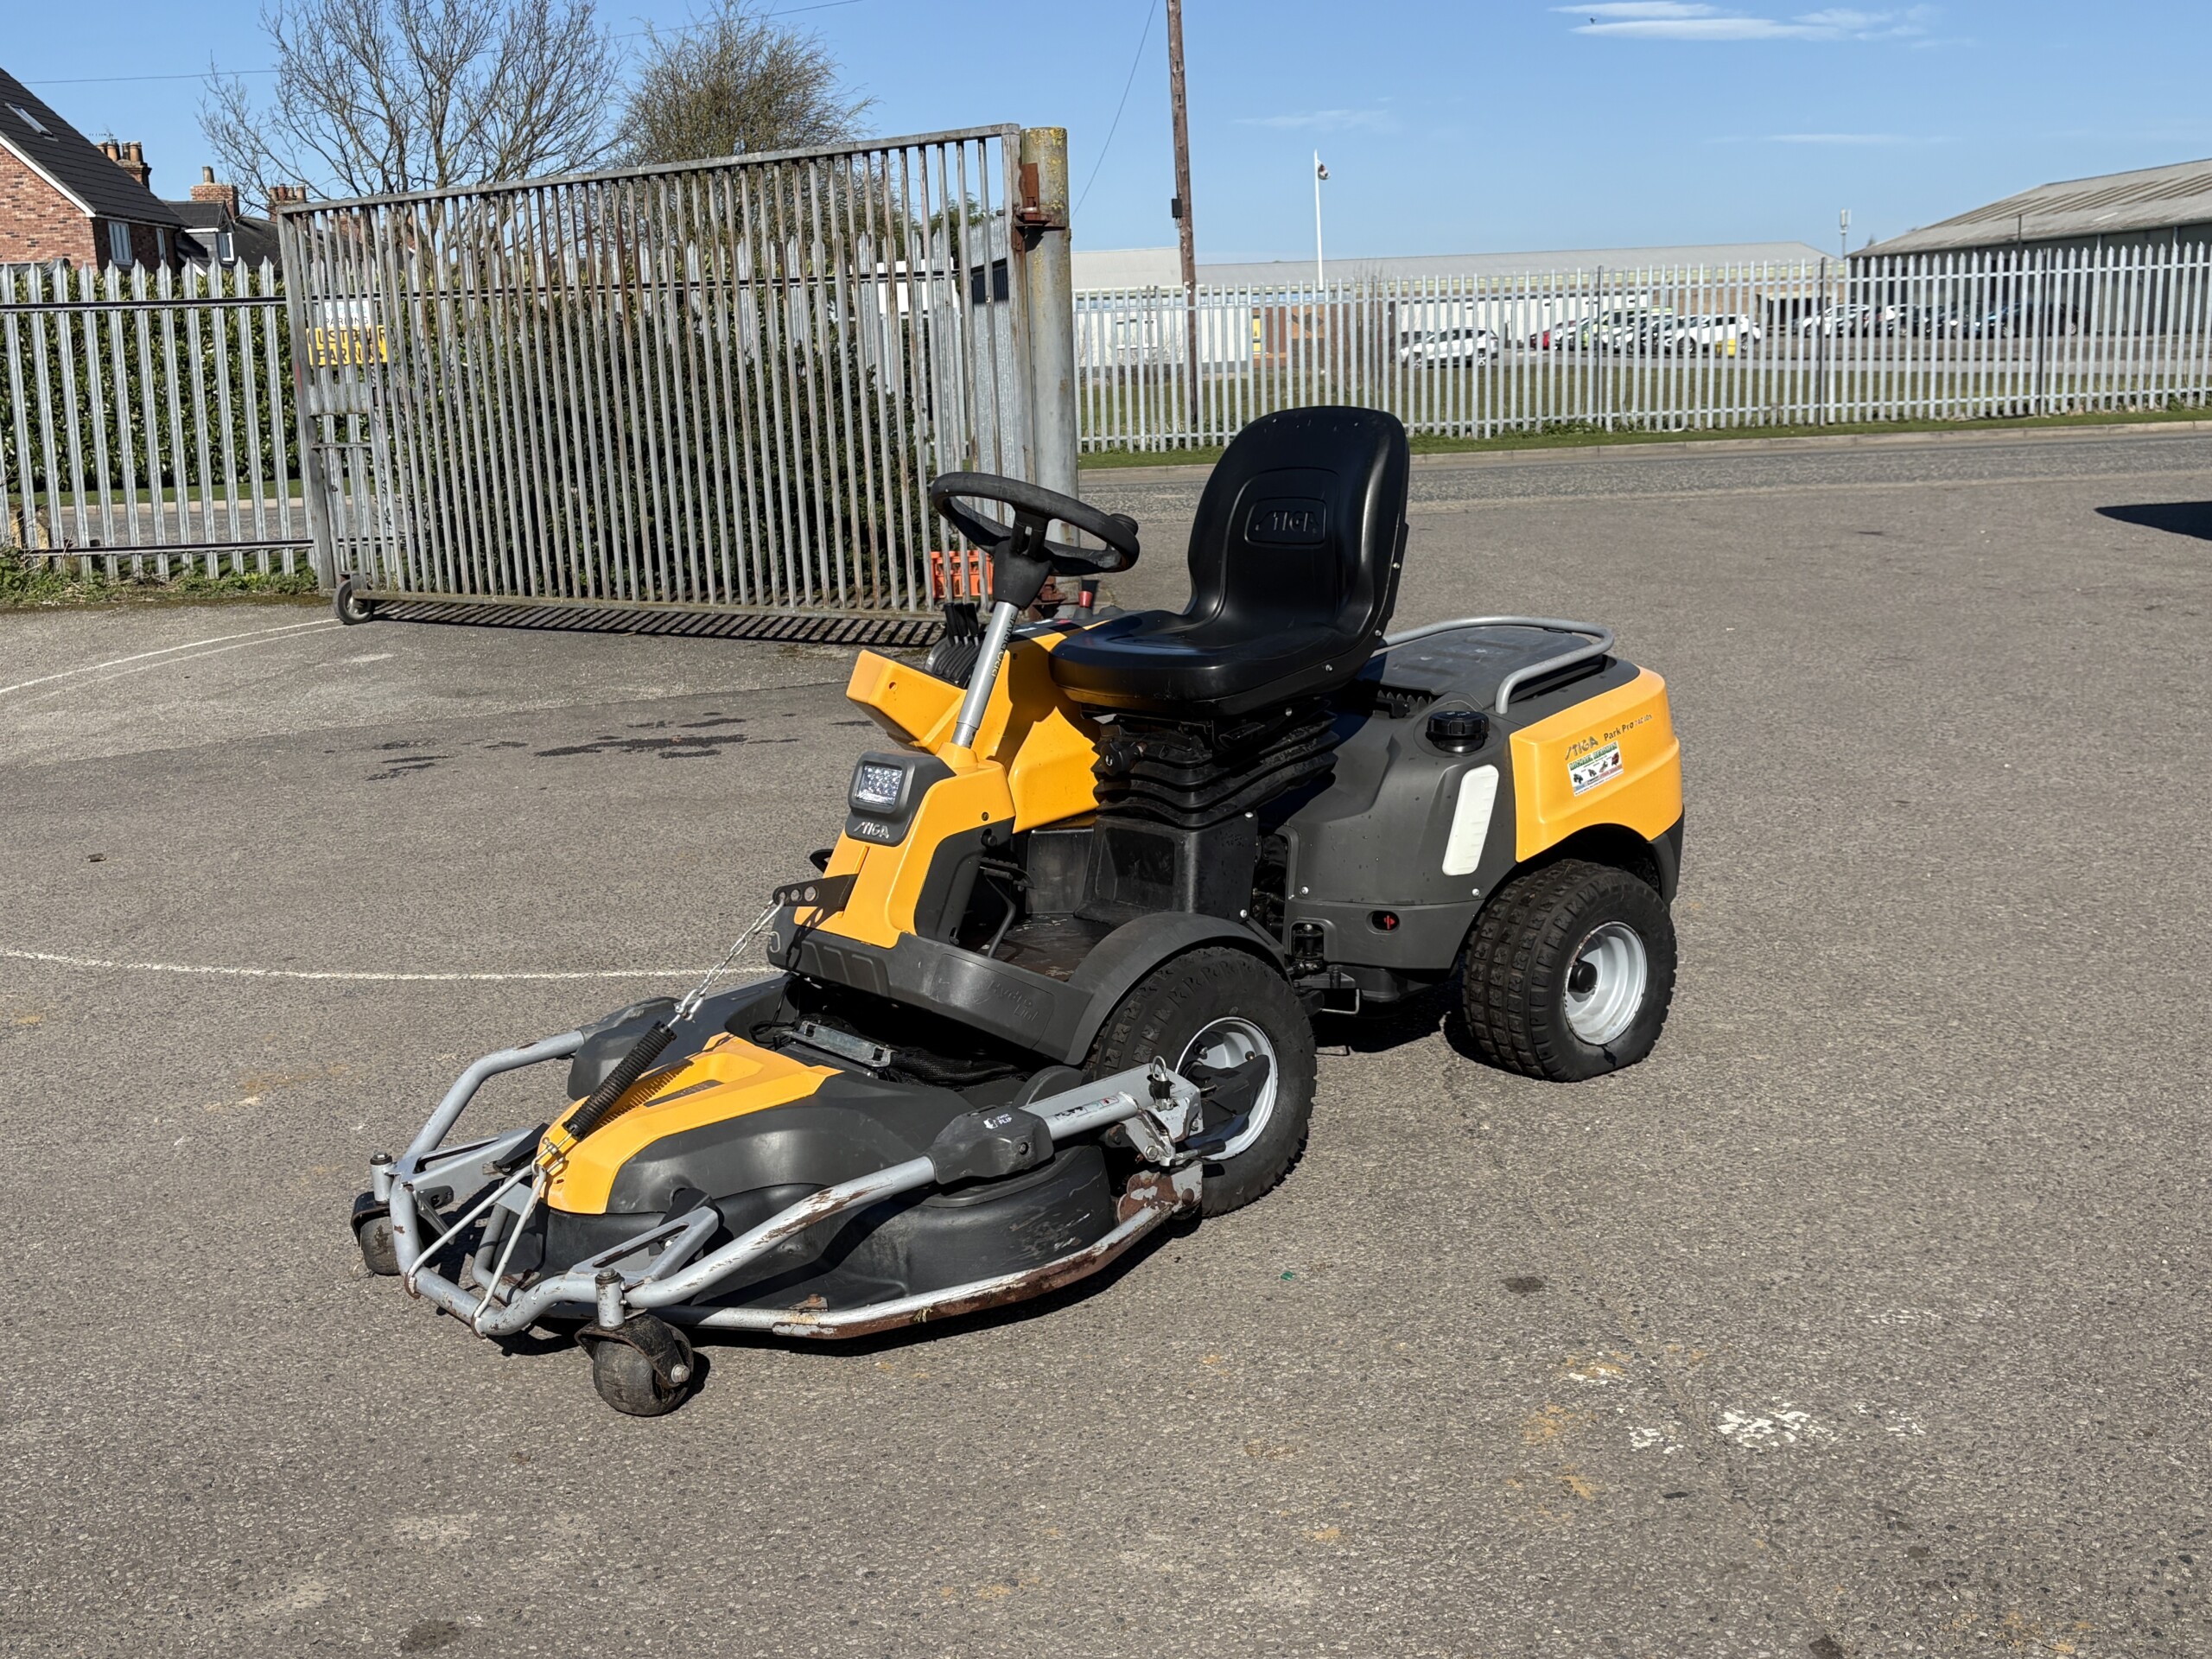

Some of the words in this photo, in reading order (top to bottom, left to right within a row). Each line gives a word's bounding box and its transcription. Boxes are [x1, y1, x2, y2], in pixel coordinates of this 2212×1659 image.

[1565, 735, 1599, 760] STIGA
[1604, 728, 1621, 741] Park
[1622, 721, 1634, 733] Pro
[854, 821, 889, 839] STIGA
[998, 1116, 1012, 1125] FLIP
